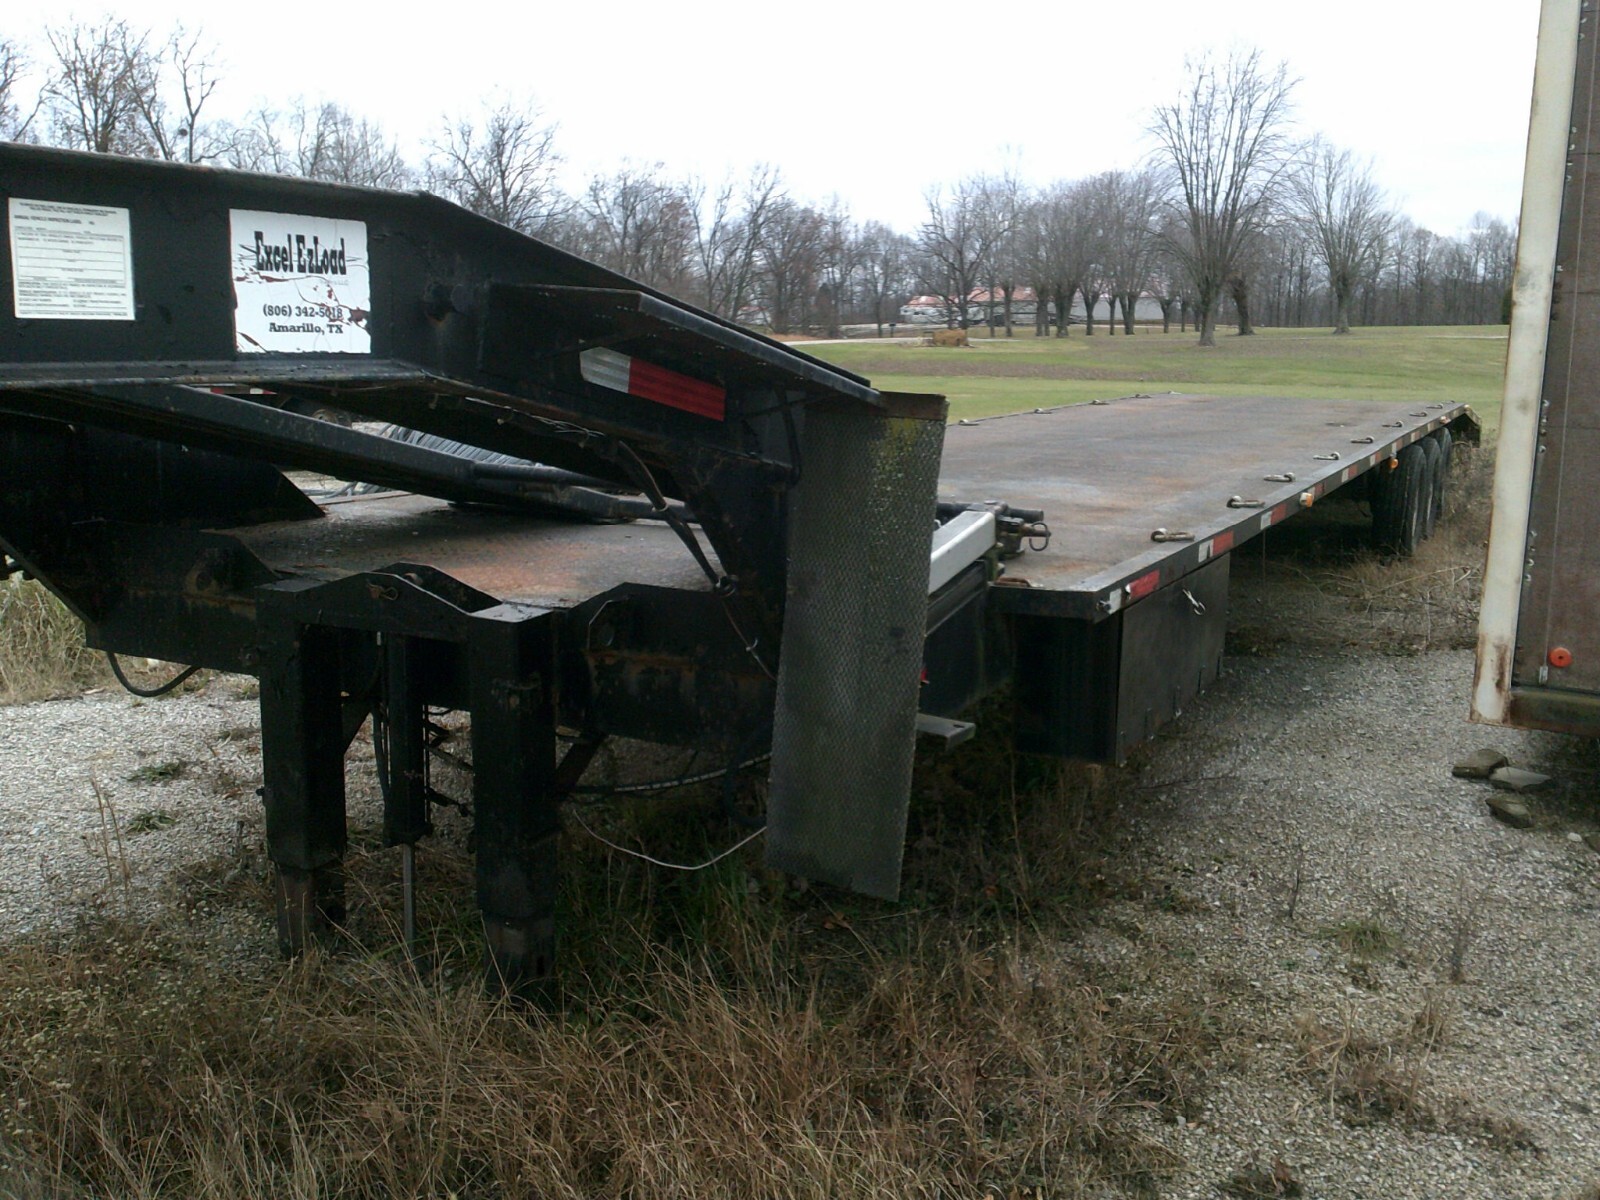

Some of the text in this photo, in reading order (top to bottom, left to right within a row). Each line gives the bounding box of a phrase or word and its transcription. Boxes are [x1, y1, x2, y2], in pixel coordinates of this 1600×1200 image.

[254, 230, 347, 275] Excel EzLoad
[262, 303, 292, 318] (806)
[269, 322, 344, 335] Amarillo, TX
